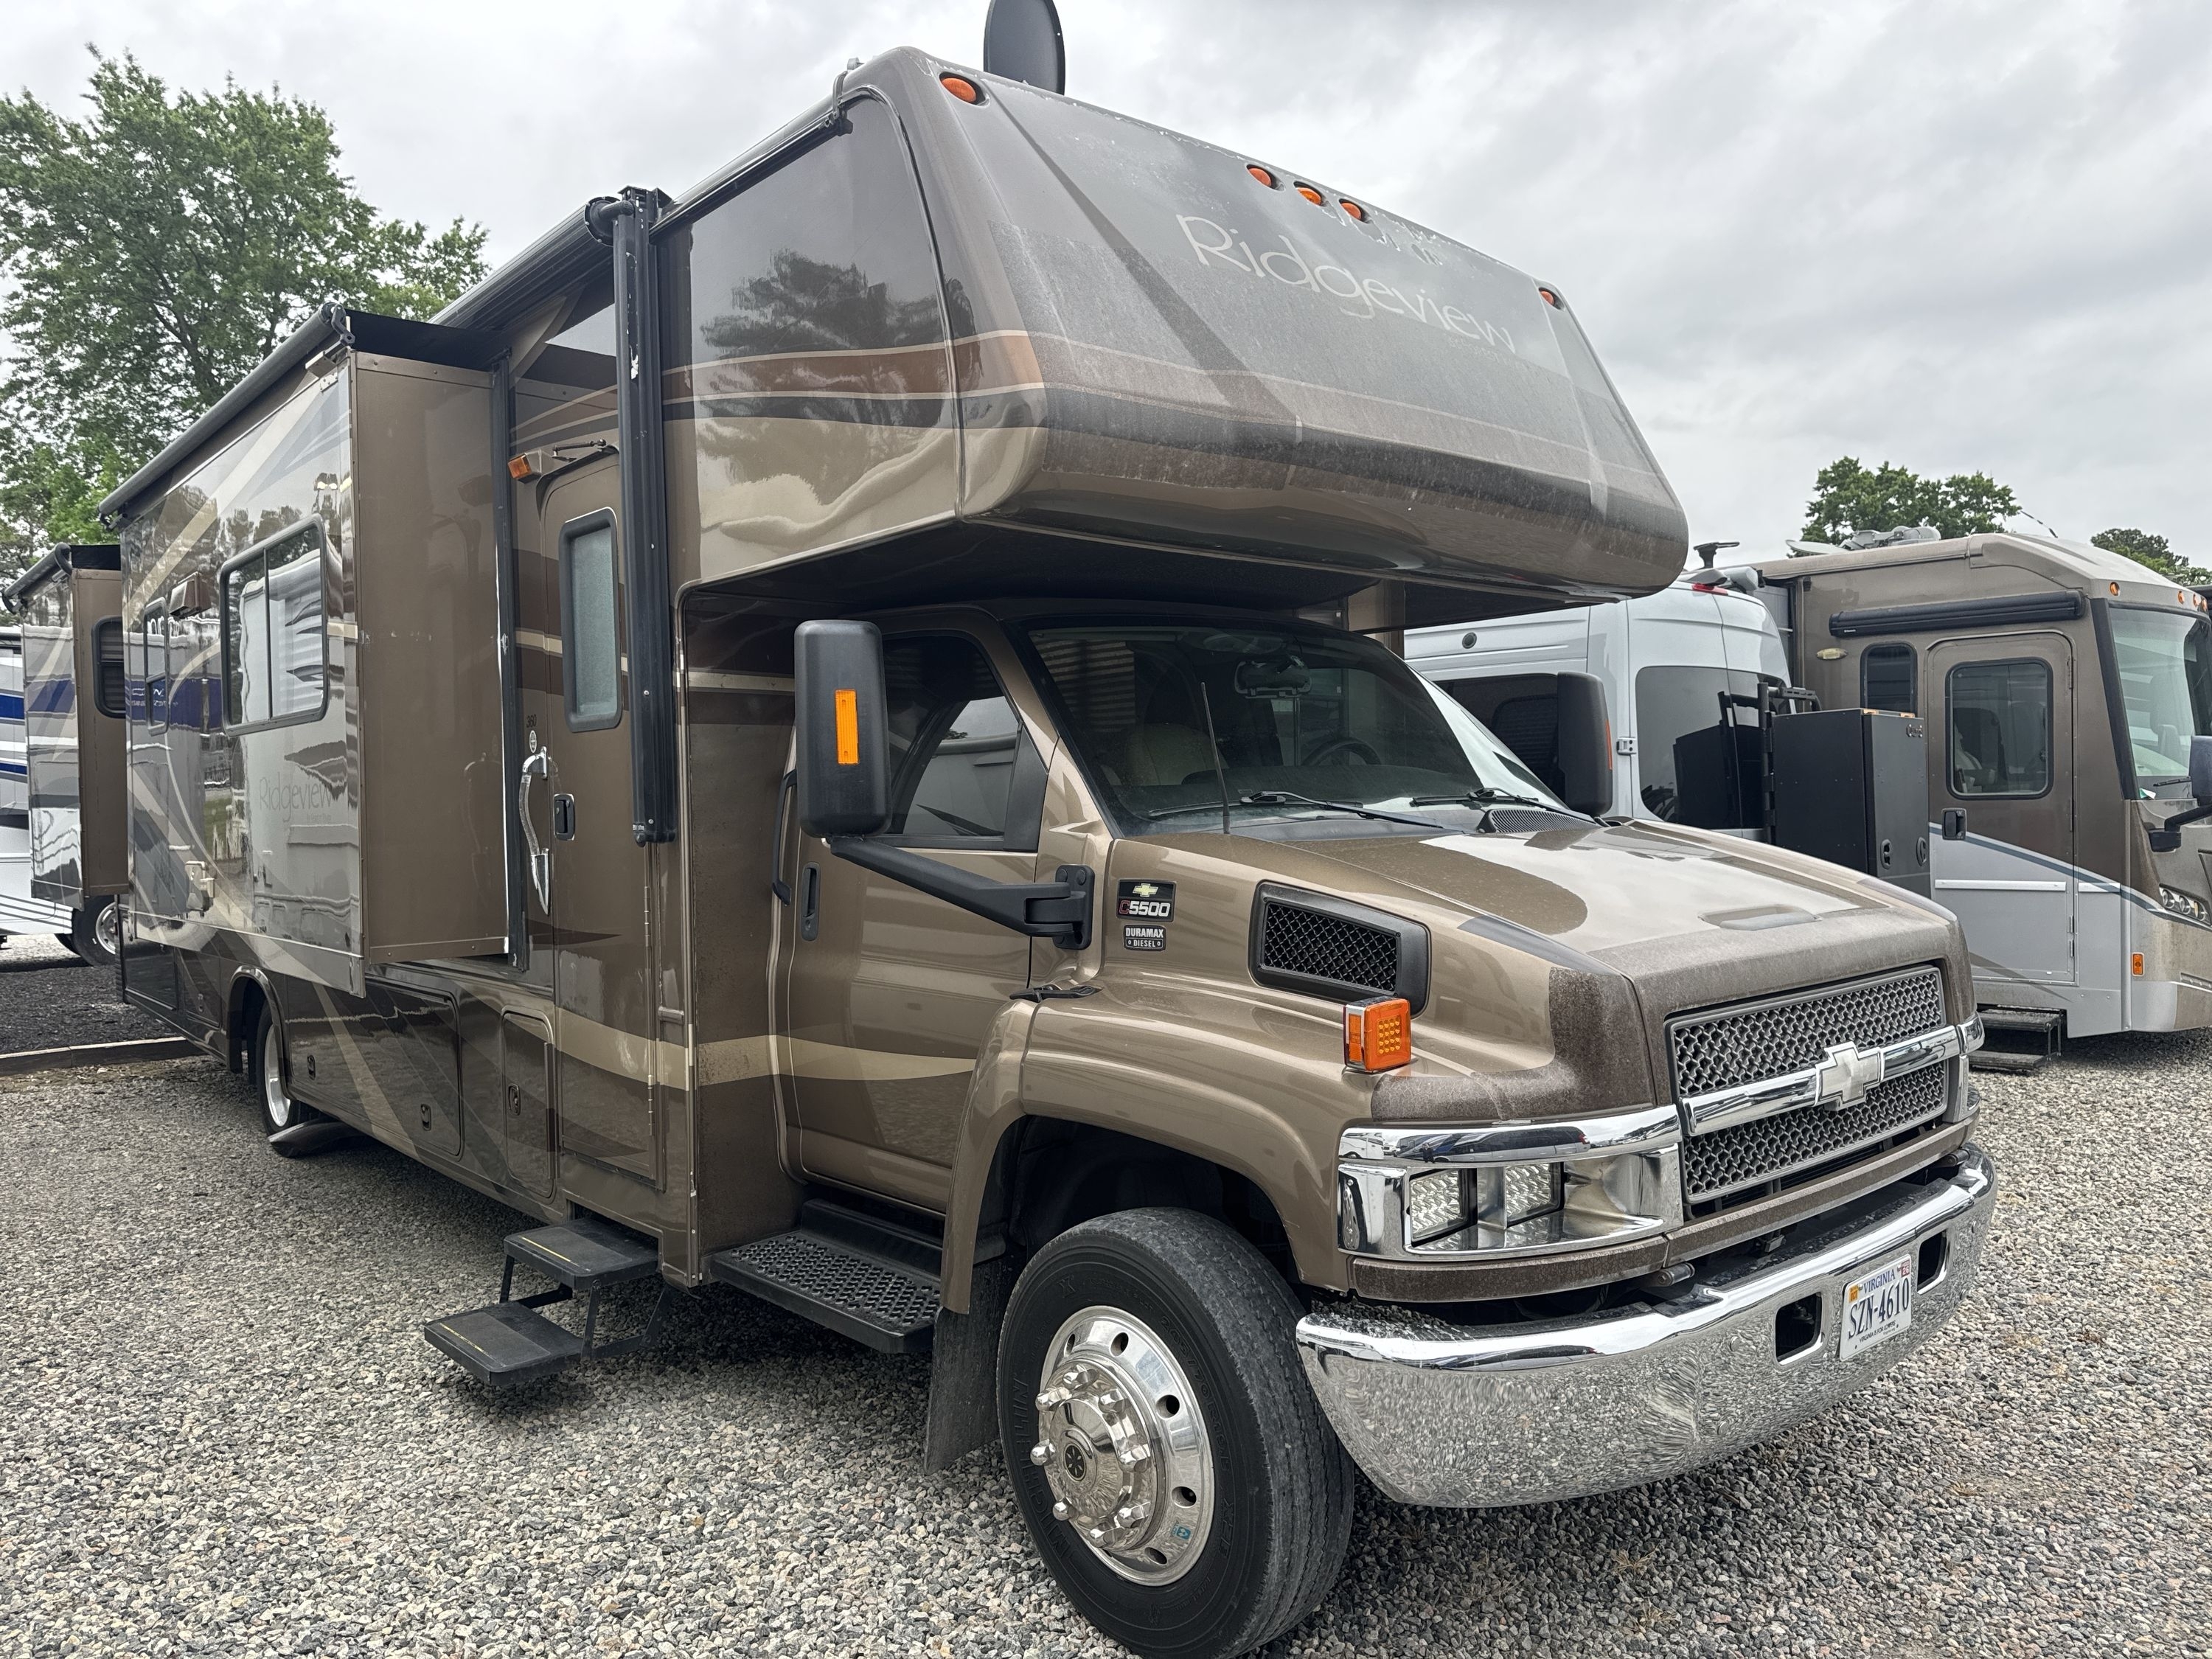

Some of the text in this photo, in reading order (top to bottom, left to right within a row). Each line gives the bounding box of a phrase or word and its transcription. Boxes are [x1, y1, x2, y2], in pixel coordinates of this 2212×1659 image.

[1176, 214, 1515, 354] Ridgeview
[259, 771, 332, 823] Ridgeview
[1119, 900, 1171, 917] C5500
[1125, 928, 1164, 938] DURAMAX
[1133, 939, 1155, 947] DIESEL
[1863, 1269, 1896, 1294] VIRGINIA
[1848, 1277, 1910, 1340] SZN-4610
